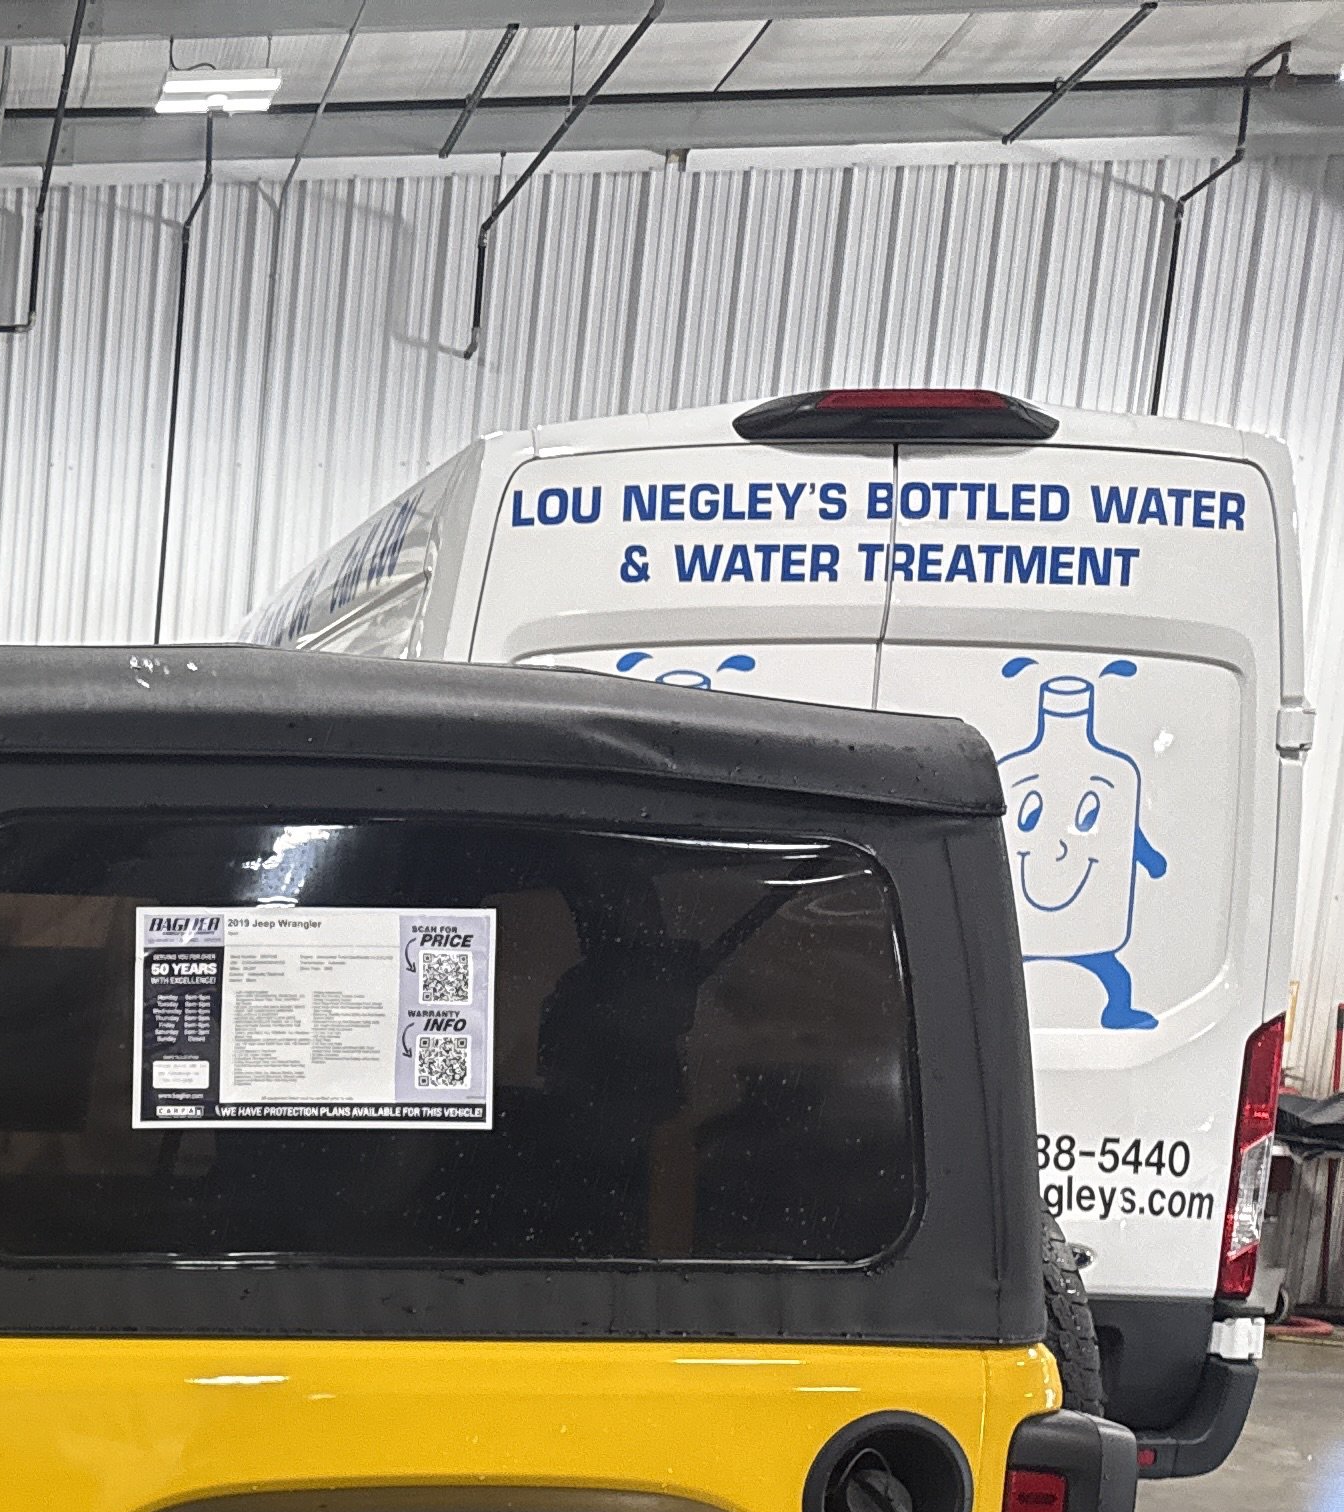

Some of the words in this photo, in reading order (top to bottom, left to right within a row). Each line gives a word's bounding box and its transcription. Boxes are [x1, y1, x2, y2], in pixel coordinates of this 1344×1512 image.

[512, 486, 602, 527] LOU
[622, 483, 848, 522] NEGLEY'S
[867, 482, 1070, 522] BOTTLED
[1091, 485, 1246, 531] WATER
[620, 544, 651, 583] &
[674, 544, 840, 583] WATER
[858, 543, 1141, 586] TREATMENT
[227, 918, 250, 928] 2019
[252, 919, 276, 929] Jeep
[278, 919, 323, 930] Wrangler
[411, 925, 437, 933] SCAN
[440, 926, 458, 934] FOR
[419, 933, 474, 948] PRICE
[151, 962, 170, 976] 50
[171, 962, 218, 976] YEARS
[407, 1009, 460, 1018] WARRANTY
[423, 1018, 467, 1032] INFO
[220, 1106, 237, 1118] WE
[238, 1106, 263, 1118] HAVE
[263, 1106, 319, 1118] PROTECTION
[320, 1106, 351, 1118] PLANS
[351, 1106, 401, 1118] AVAILABLE
[402, 1106, 420, 1118] FOR
[421, 1106, 443, 1118] THIS
[1043, 1175, 1215, 1220] gleys.com
